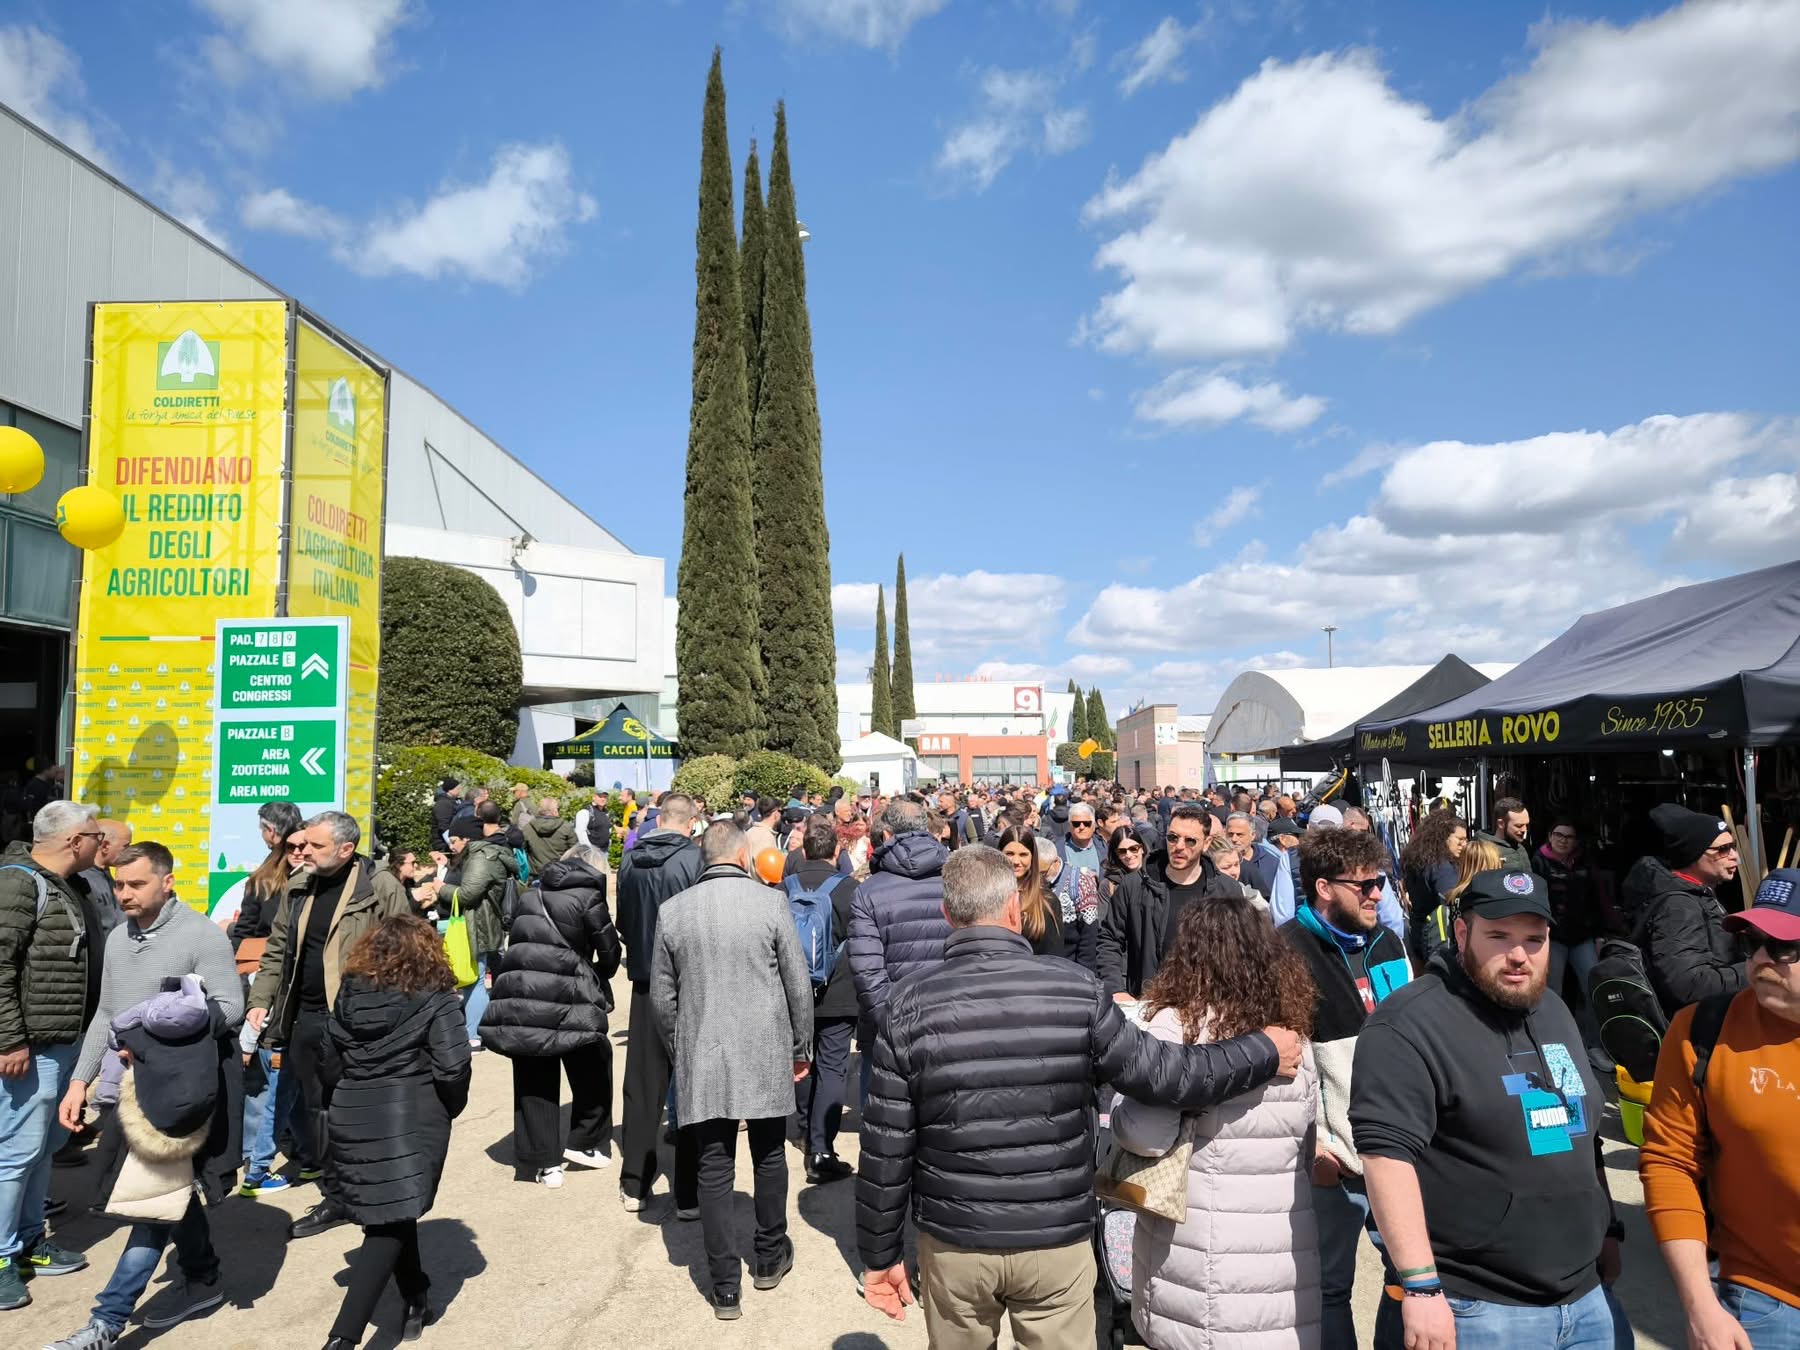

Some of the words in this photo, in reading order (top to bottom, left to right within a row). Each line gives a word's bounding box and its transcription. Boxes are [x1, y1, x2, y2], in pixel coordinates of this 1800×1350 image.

[153, 396, 220, 408] COLDIRETTI
[125, 408, 135, 420] la
[206, 407, 222, 420] del
[116, 456, 252, 485] DIFENDIAMO
[148, 493, 241, 522] REDDITO
[307, 494, 367, 544] COLDIRETTI
[149, 530, 211, 559] DEGLI
[296, 527, 374, 580] L'AGRICOLTURA
[107, 567, 250, 597] AGRICOLTORI
[312, 567, 360, 609] ITALIANA
[230, 634, 254, 646] PAD.
[229, 654, 280, 667] PIAZZALE
[249, 674, 293, 687] CENTRO
[232, 690, 292, 703] CONGRESSI
[1016, 688, 1039, 711] 9
[1600, 706, 1648, 736] Since
[1648, 697, 1708, 736] 1985
[227, 728, 278, 740] PIAZZALE
[1428, 718, 1492, 749] SELLERIA
[1502, 711, 1560, 744] ROVO
[603, 745, 645, 755] CACCIA
[921, 736, 951, 751] BAR
[261, 748, 291, 760] AREA
[231, 763, 290, 776] ZOOTECNIA
[229, 785, 258, 797] AREA
[260, 785, 290, 797] NORD
